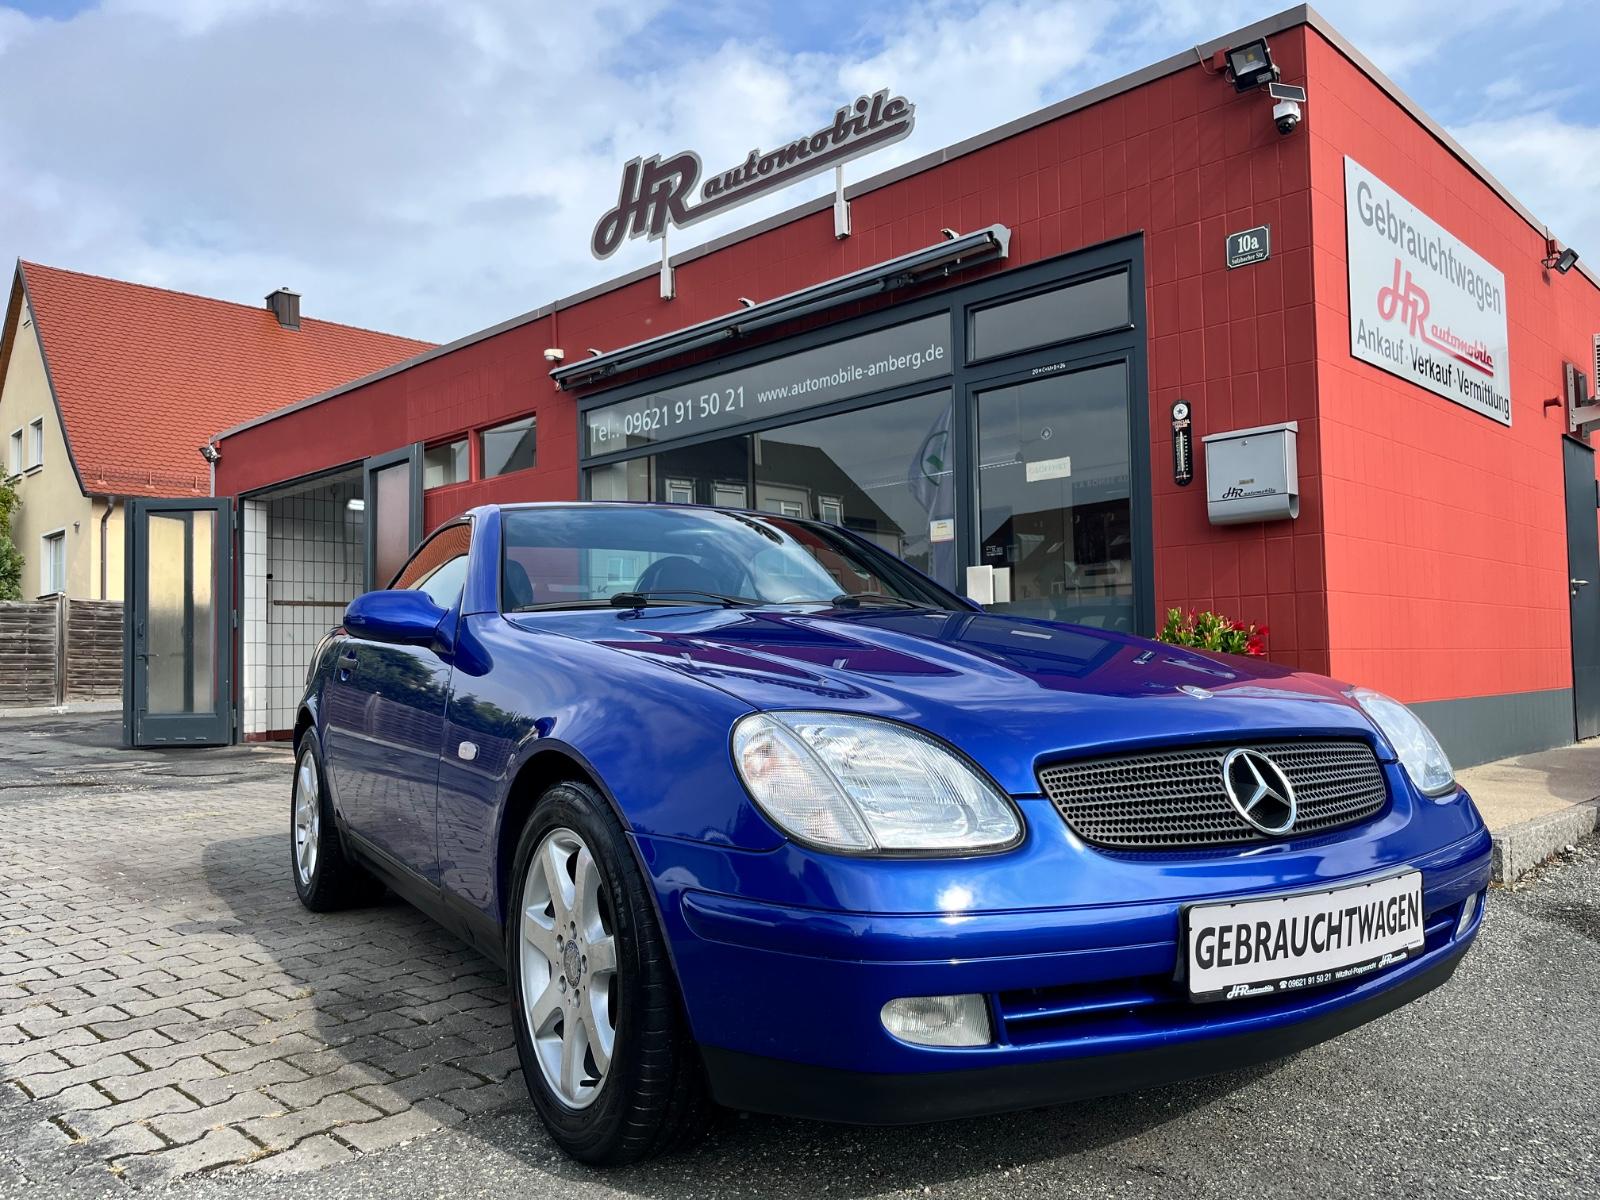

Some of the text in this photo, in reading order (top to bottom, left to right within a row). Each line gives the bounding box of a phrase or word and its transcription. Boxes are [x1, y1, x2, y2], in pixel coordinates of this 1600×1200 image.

[592, 89, 914, 259] HR automobile
[1237, 235, 1259, 254] 10a
[1356, 180, 1502, 315] Gebrauchtwagen
[1356, 318, 1510, 420] Ankauf Verkauf Vermittlung
[1431, 322, 1494, 369] automobile
[591, 343, 945, 443] Tel.: 09621 91 50 21 www.automobile-amberg.de
[1195, 890, 1419, 970] GEBRAUCHTWAGEN
[1287, 977, 1307, 989] 09621
[1307, 975, 1315, 986] 91
[1316, 973, 1324, 984] 50
[1324, 972, 1332, 982] 21
